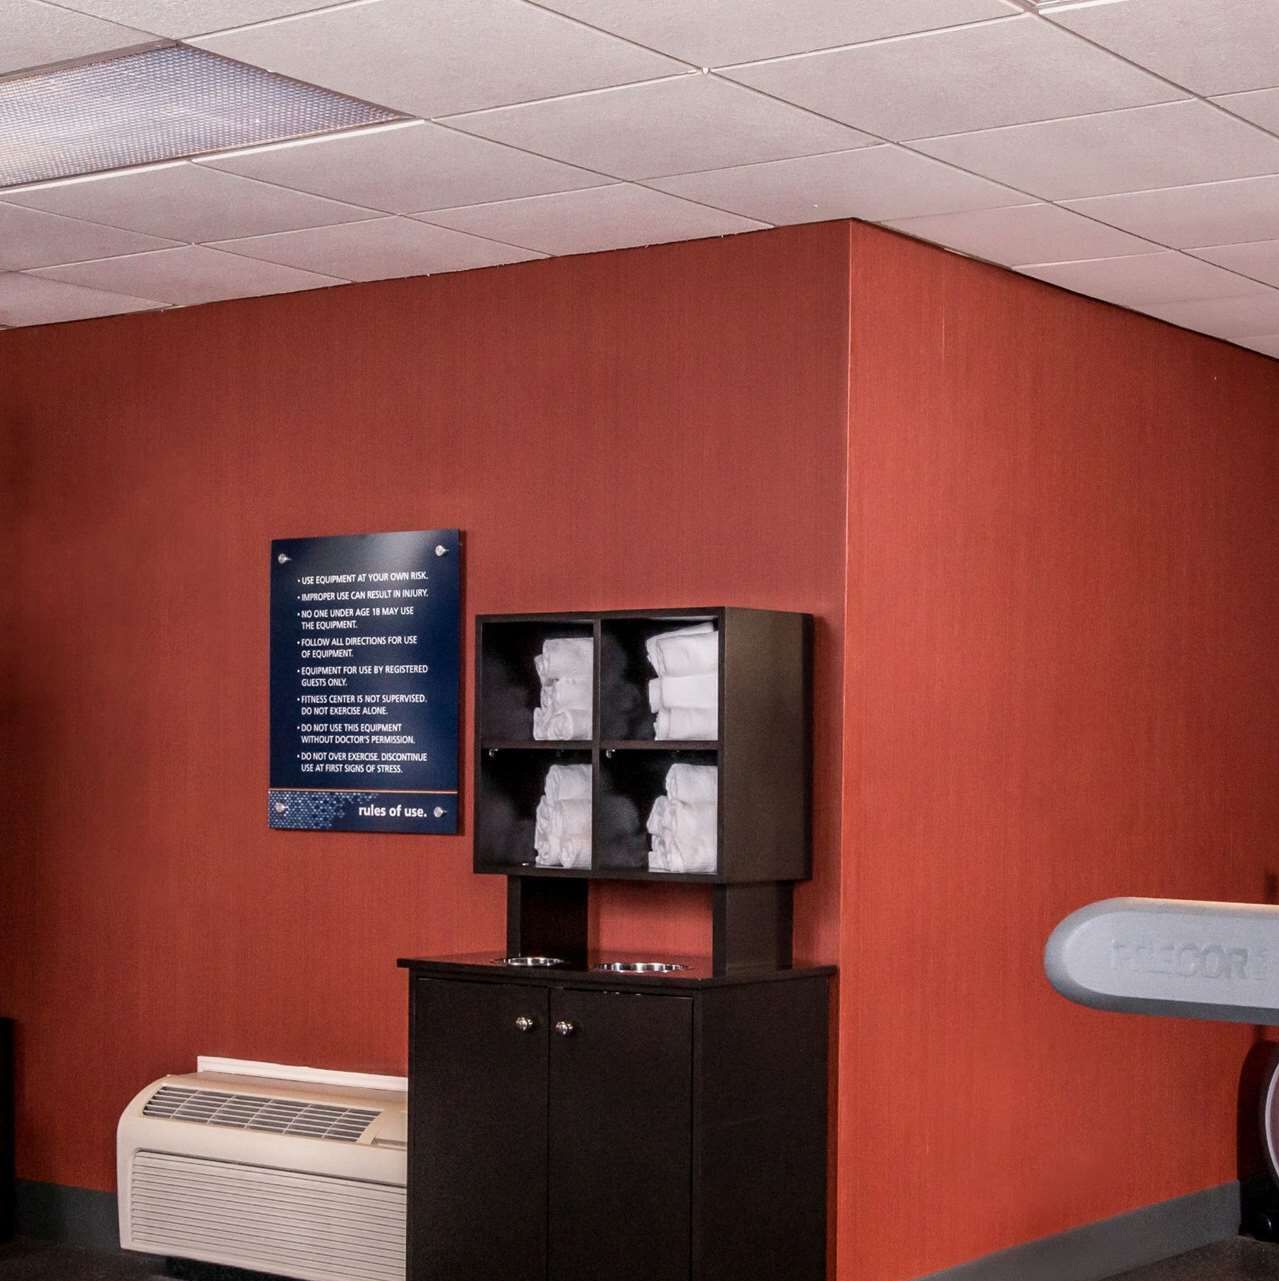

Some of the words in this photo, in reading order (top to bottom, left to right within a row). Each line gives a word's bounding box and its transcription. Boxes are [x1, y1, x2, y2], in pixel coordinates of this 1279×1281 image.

[302, 576, 315, 585] USE
[316, 574, 356, 585] EQUIPMENT
[358, 573, 367, 583] AT
[368, 572, 389, 582] YOUR
[390, 571, 409, 581] OWN
[302, 592, 335, 601] IMPROPER
[337, 591, 349, 600] USE
[351, 591, 365, 600] CAN
[367, 589, 391, 599] RESULT
[393, 589, 400, 598] IN
[301, 609, 312, 618] NO
[314, 609, 328, 618] ONE
[330, 608, 353, 617] UNDER
[355, 607, 370, 616] AGE
[372, 607, 380, 616] 18
[382, 606, 399, 615] MAY
[401, 606, 414, 615] USE
[302, 621, 314, 630] THE
[302, 637, 330, 646] FOLLOW
[331, 637, 344, 646] ALL
[346, 636, 386, 646] DIRECTIONS
[388, 635, 402, 645] FOR
[404, 635, 418, 644] USE
[302, 649, 311, 658] OF
[302, 666, 342, 675] EQUIPMENT
[343, 665, 357, 675] FOR
[359, 665, 372, 674] USE
[373, 665, 383, 674] BY
[385, 664, 428, 674] REGISTERED
[302, 678, 326, 687] GUESTS
[302, 694, 328, 704] FITNESS
[329, 694, 356, 704] CENTER
[357, 694, 363, 703] IS
[365, 694, 381, 703] NOT
[302, 706, 313, 716] DO
[314, 706, 328, 716] NOT
[330, 706, 361, 715] EXERCISE
[301, 723, 313, 732] DO
[314, 723, 328, 732] NOT
[330, 723, 343, 732] USE
[344, 723, 359, 732] THIS
[360, 723, 402, 733] EQUIPMENT
[301, 735, 334, 744] WITHOUT
[335, 735, 370, 744] DOCTOR'S
[301, 752, 312, 761] DO
[313, 752, 327, 761] NOT
[328, 752, 347, 761] OVER
[381, 752, 428, 762] DISCONTINUE
[301, 763, 314, 772] USE
[315, 763, 325, 772] AT
[326, 763, 343, 772] FIRST
[344, 763, 365, 773] SIGNS
[365, 764, 376, 773] OF
[358, 803, 387, 817] rules
[389, 804, 402, 817] of
[404, 807, 428, 818] use.
